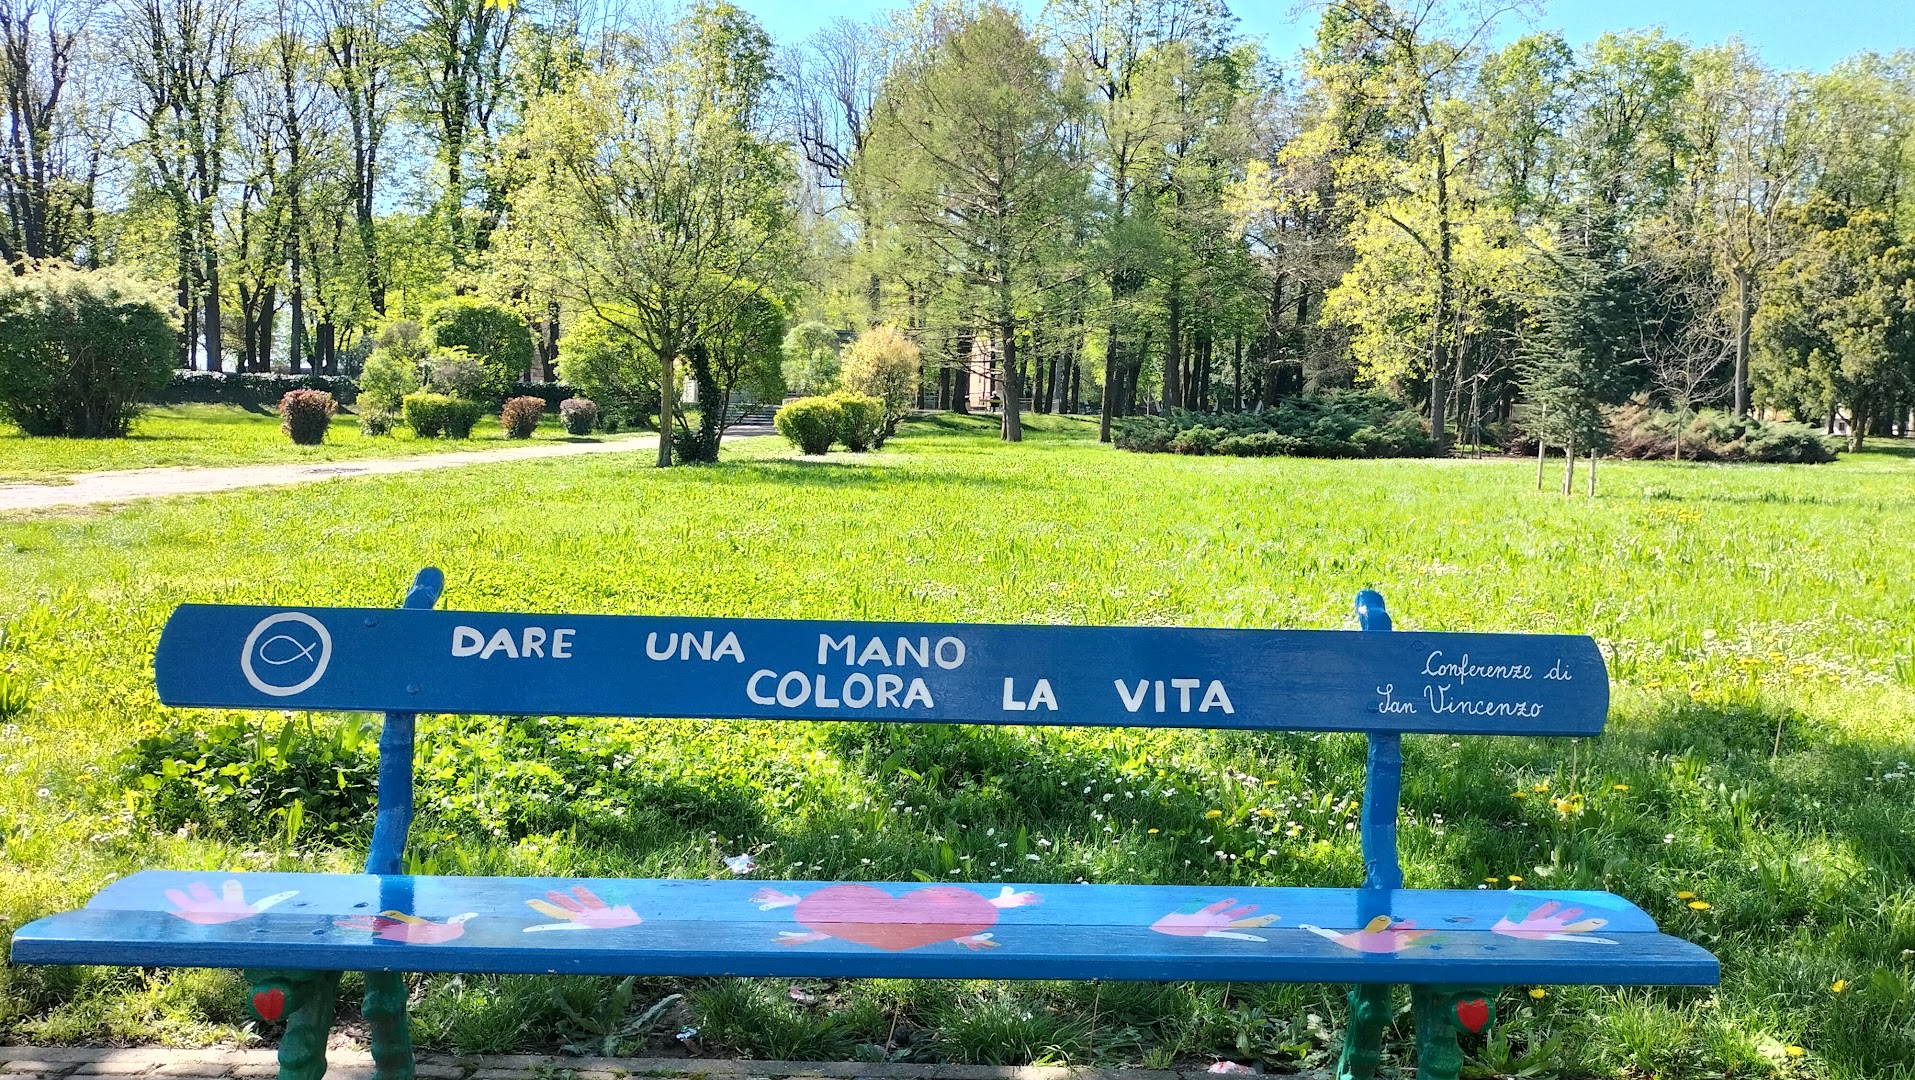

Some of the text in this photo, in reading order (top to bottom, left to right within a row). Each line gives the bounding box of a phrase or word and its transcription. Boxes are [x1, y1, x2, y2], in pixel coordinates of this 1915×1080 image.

[451, 625, 966, 669] DARE UNA MANO
[1421, 650, 1572, 685] Conferenze di
[746, 669, 1236, 714] COLORA LA VITA
[1376, 683, 1544, 717] San Vincenzo
